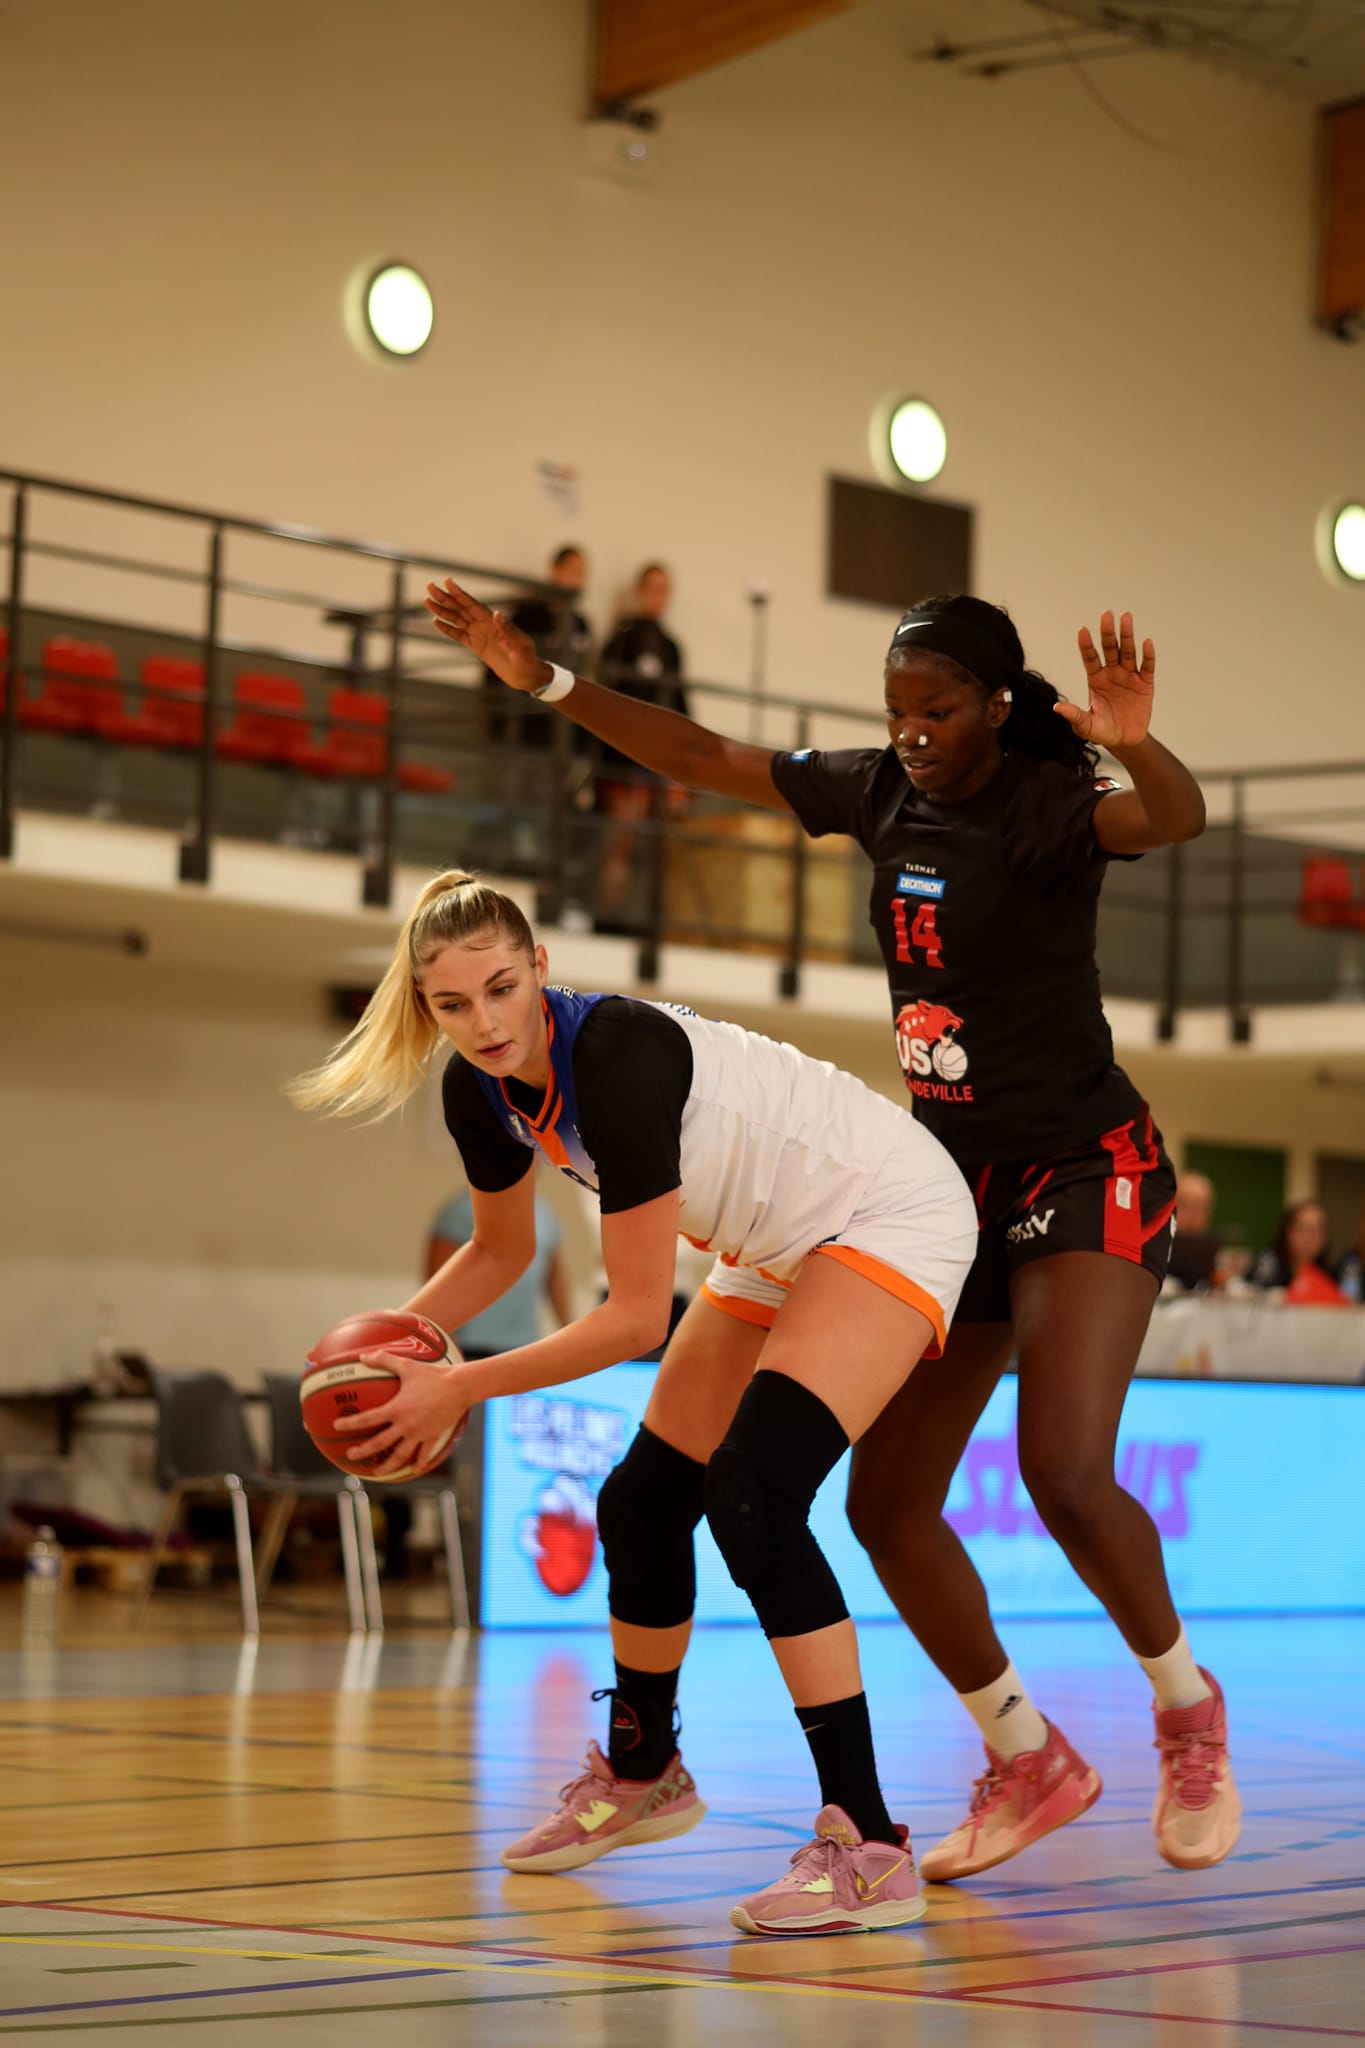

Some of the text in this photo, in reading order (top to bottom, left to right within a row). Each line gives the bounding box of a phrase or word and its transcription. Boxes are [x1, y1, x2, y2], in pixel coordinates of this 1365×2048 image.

[905, 863, 936, 875] TARMAK
[890, 898, 945, 969] 14
[906, 1078, 974, 1102] NDEVILLE
